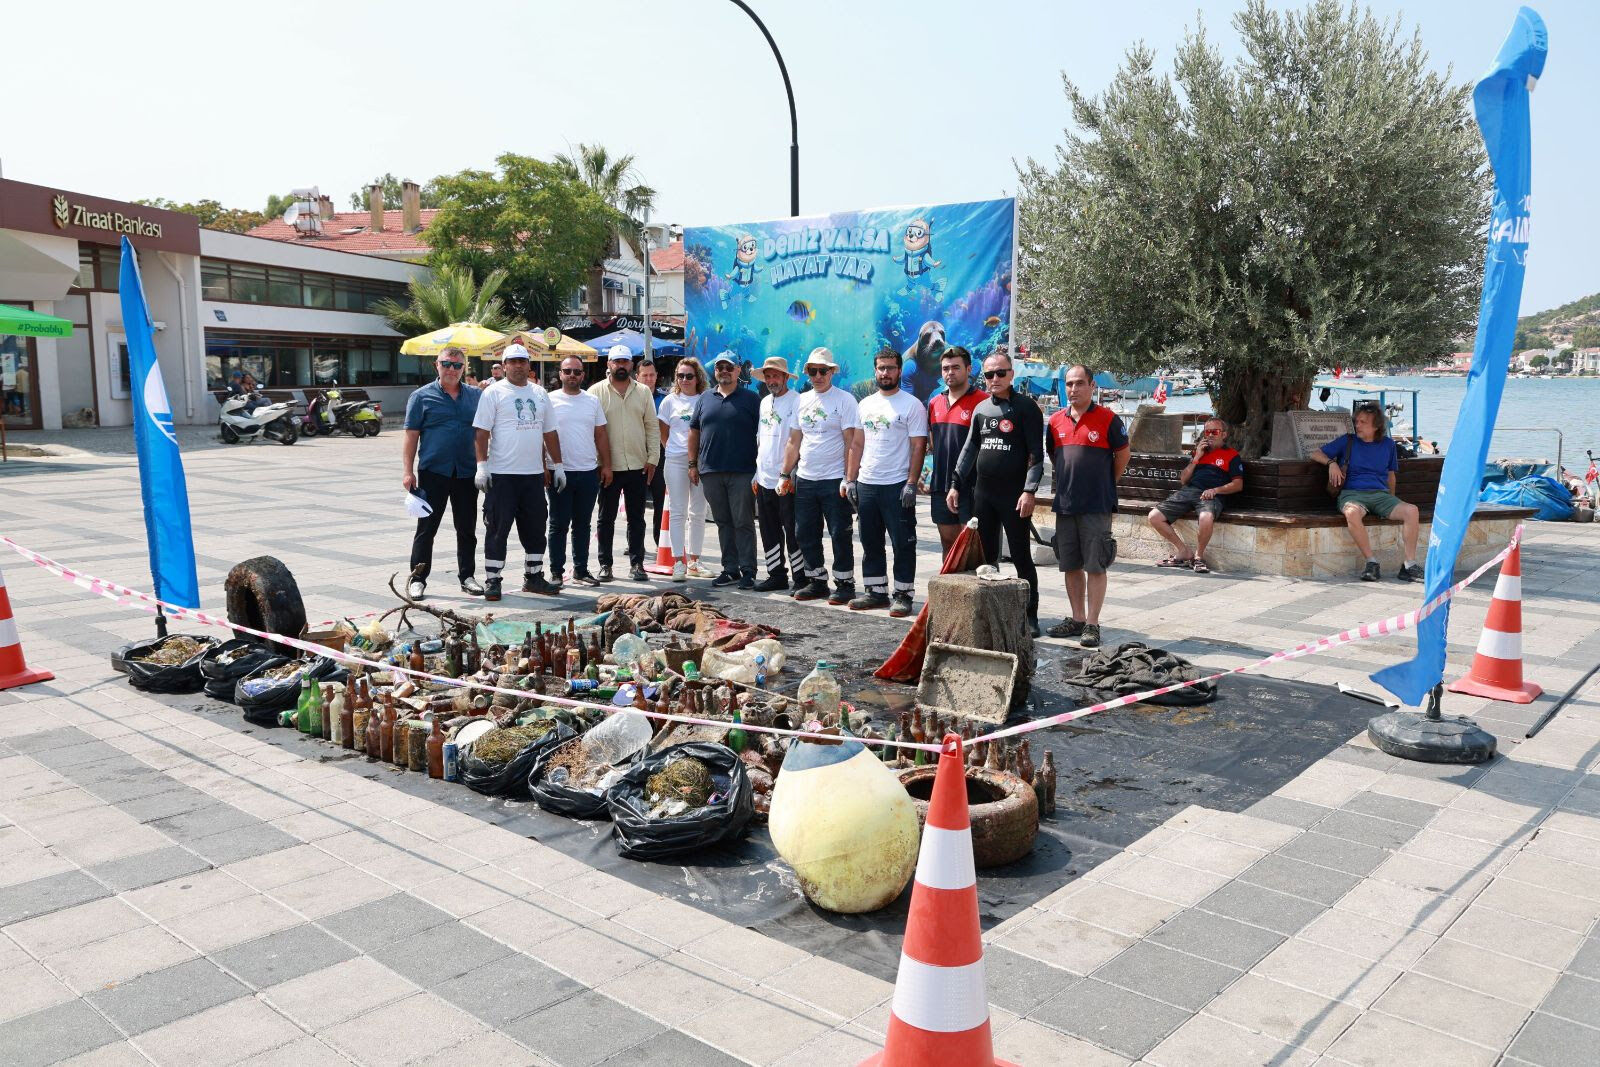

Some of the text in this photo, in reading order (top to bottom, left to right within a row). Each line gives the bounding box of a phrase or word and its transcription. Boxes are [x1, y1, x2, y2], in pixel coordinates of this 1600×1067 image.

[73, 204, 162, 238] Ziraat Bankası
[822, 226, 890, 253] VARSA
[770, 254, 874, 288] HAYAT VAR
[17, 323, 63, 336] #Probably
